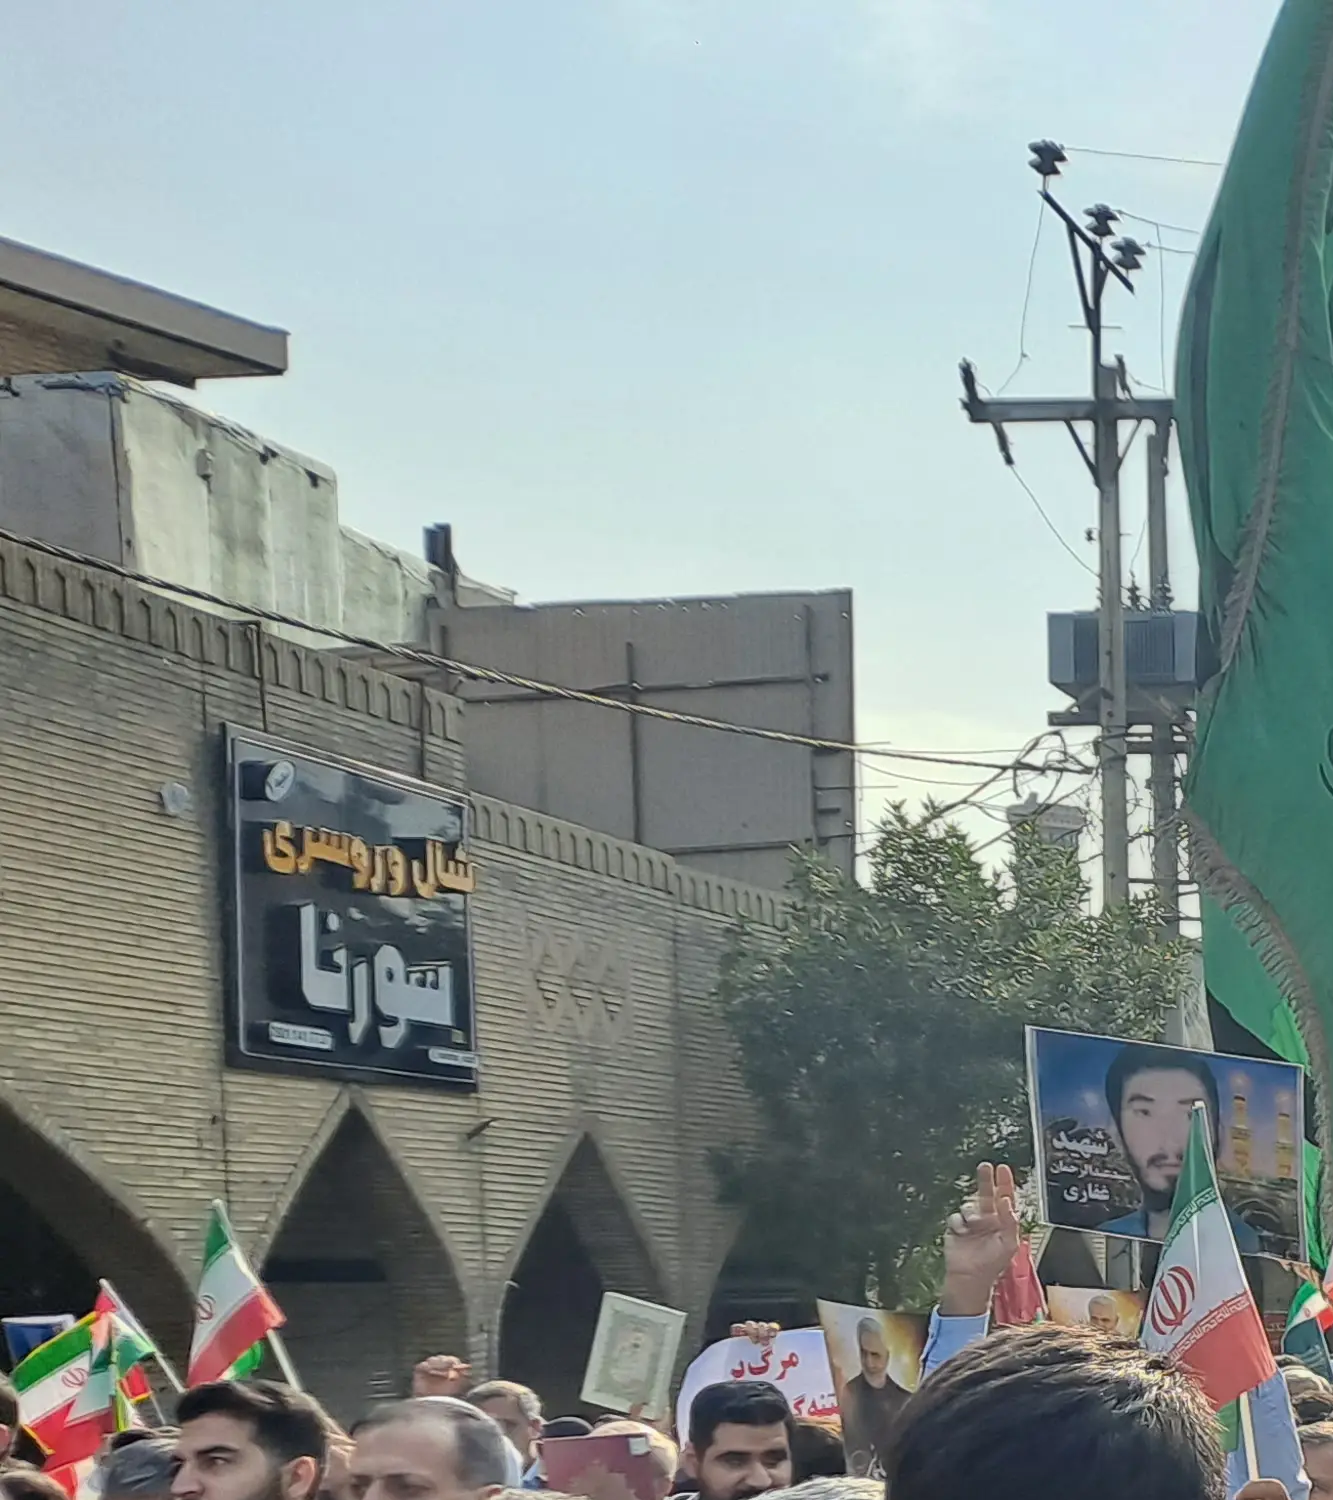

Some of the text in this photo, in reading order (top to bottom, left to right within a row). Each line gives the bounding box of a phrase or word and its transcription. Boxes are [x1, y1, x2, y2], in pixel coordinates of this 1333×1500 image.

[412, 838, 476, 899] شال
[300, 902, 456, 1049] سورنا
[1052, 1130, 1109, 1158] شهید
[1063, 1182, 1110, 1203] غفاری
[748, 1346, 800, 1381] مرگ
